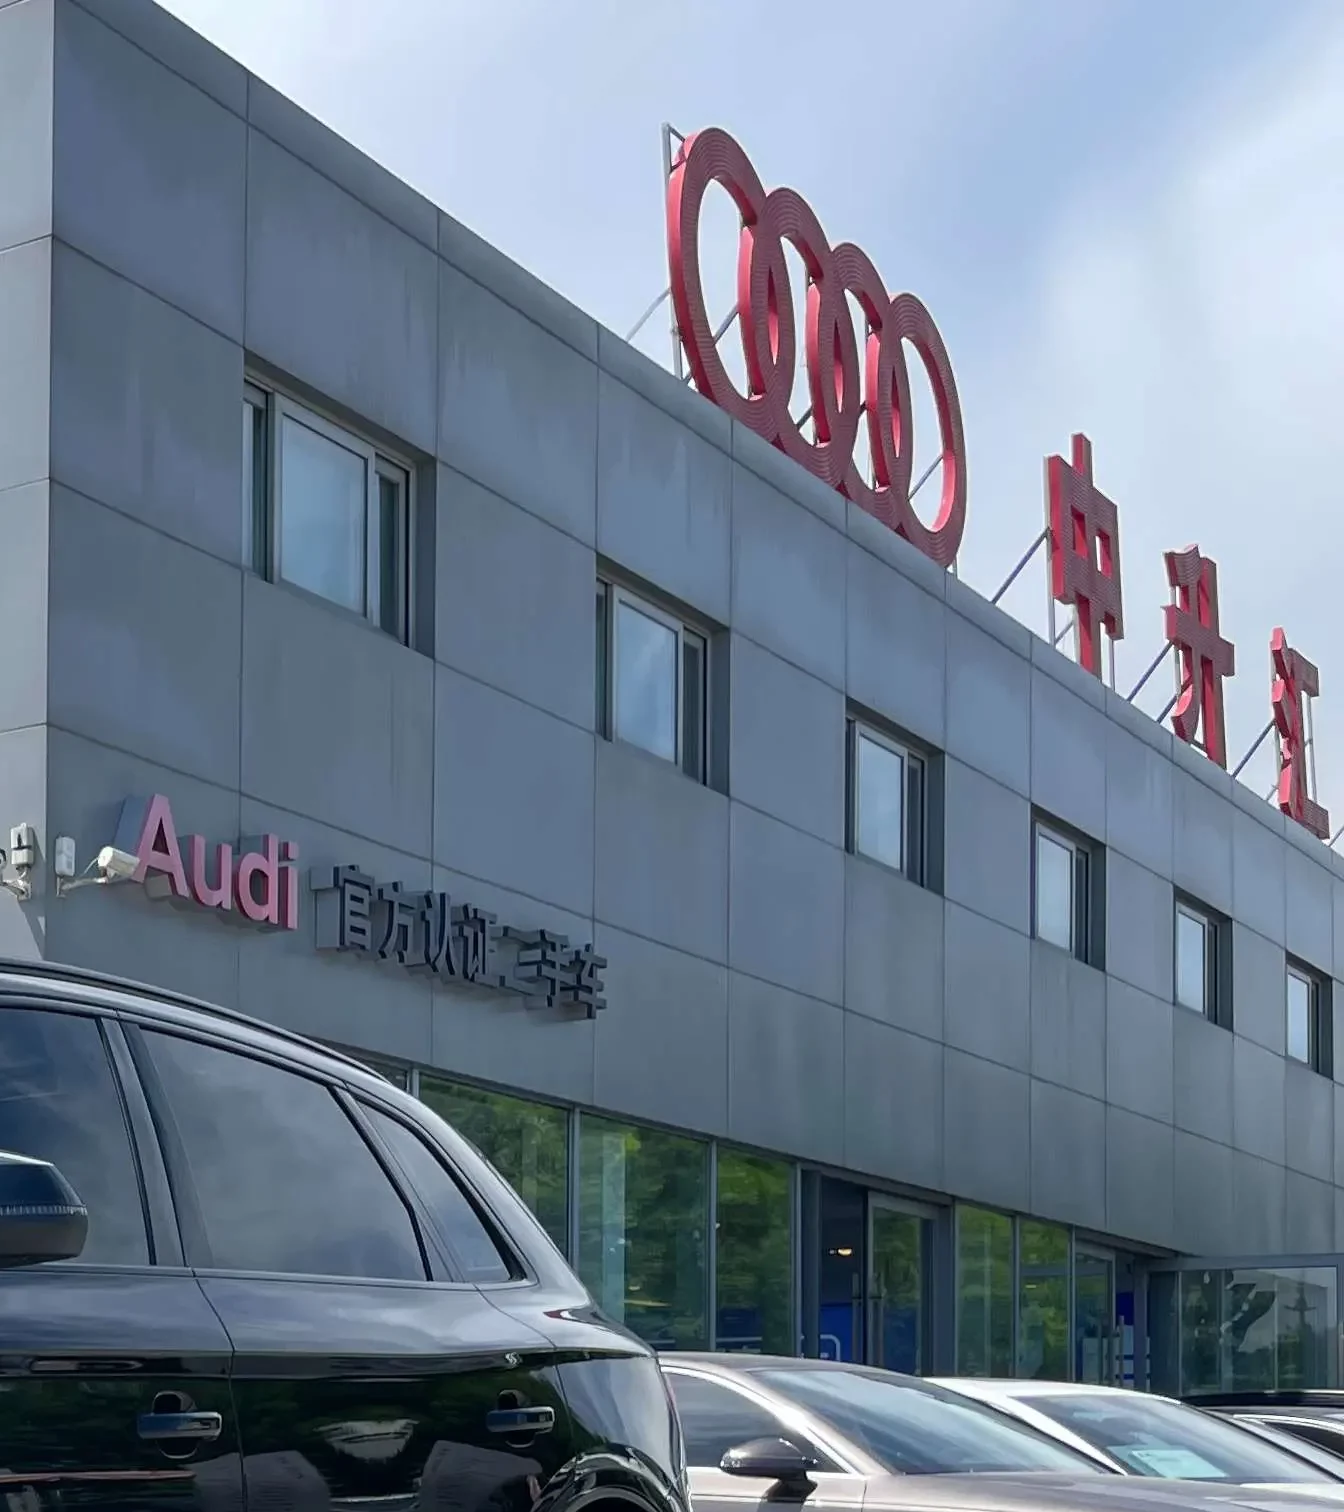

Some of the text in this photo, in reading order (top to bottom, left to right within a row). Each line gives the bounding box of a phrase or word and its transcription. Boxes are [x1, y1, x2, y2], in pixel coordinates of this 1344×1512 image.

[130, 793, 607, 1019] Audi 官方认证二手车
